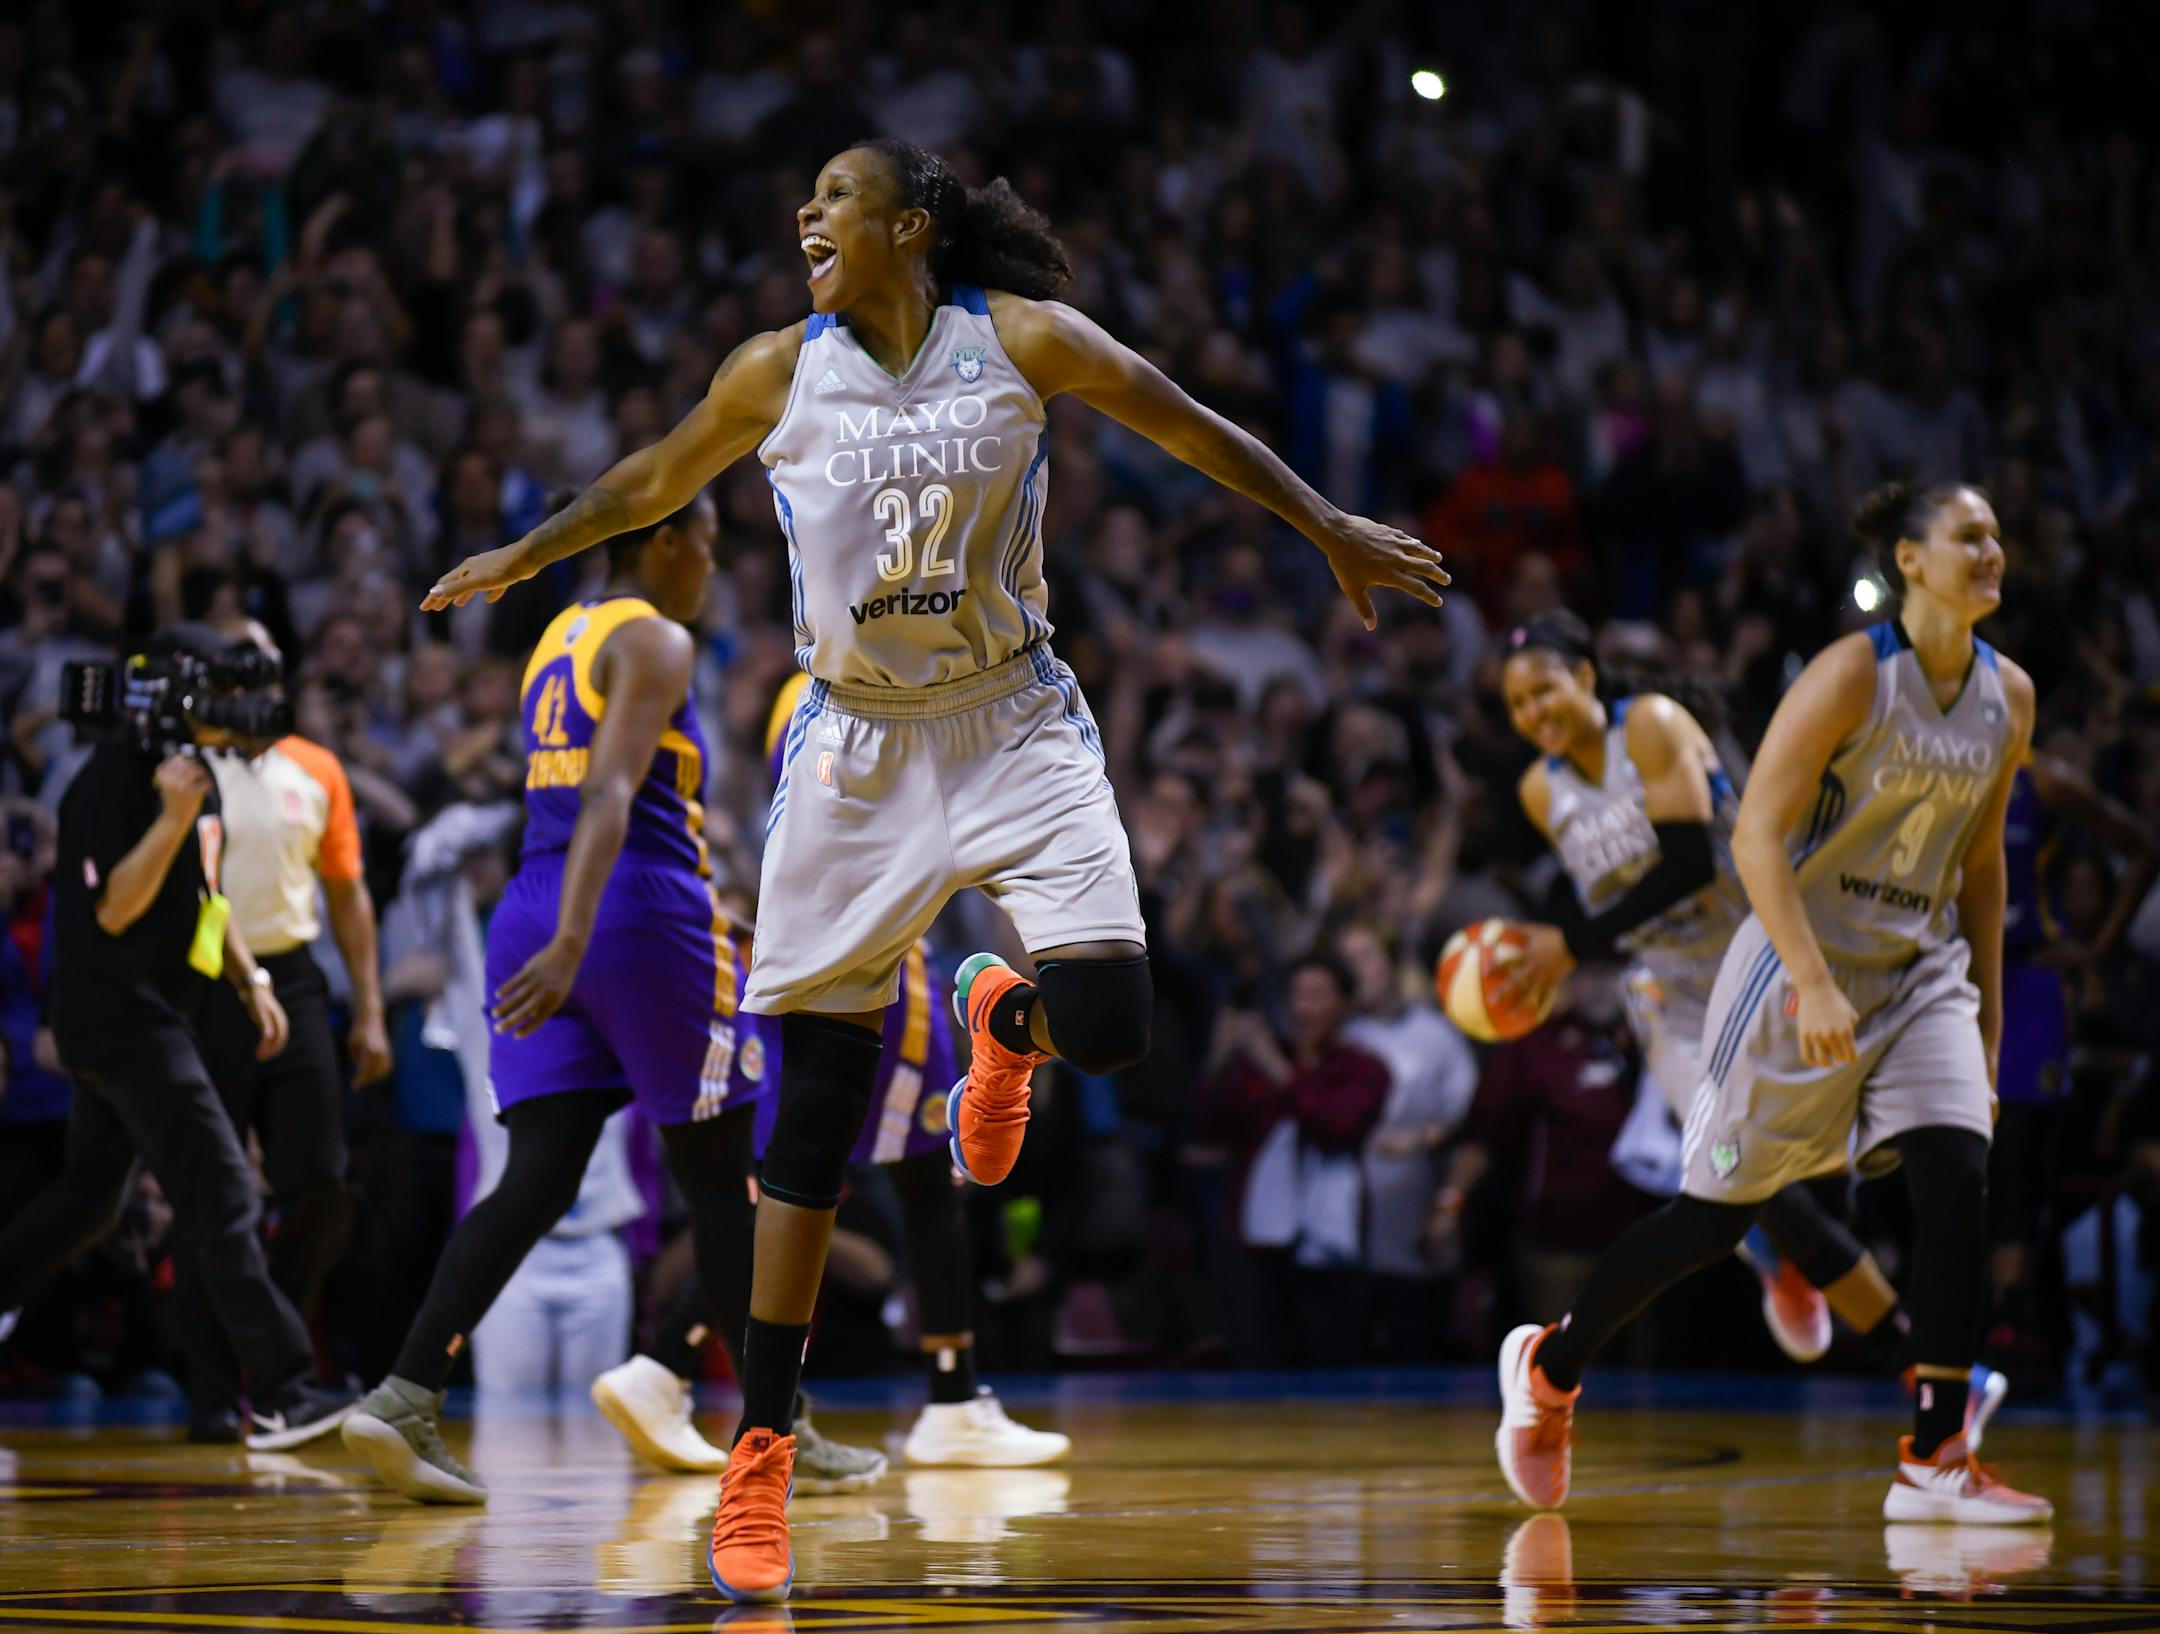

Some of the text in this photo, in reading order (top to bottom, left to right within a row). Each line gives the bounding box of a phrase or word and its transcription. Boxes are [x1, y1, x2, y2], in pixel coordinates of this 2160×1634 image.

[835, 395, 988, 443] MAYO
[825, 436, 1002, 487] CLINIC
[873, 483, 956, 581] 32
[1892, 731, 1992, 774] MAYO
[1892, 801, 1936, 877] 9
[1839, 874, 1930, 914] verizon
